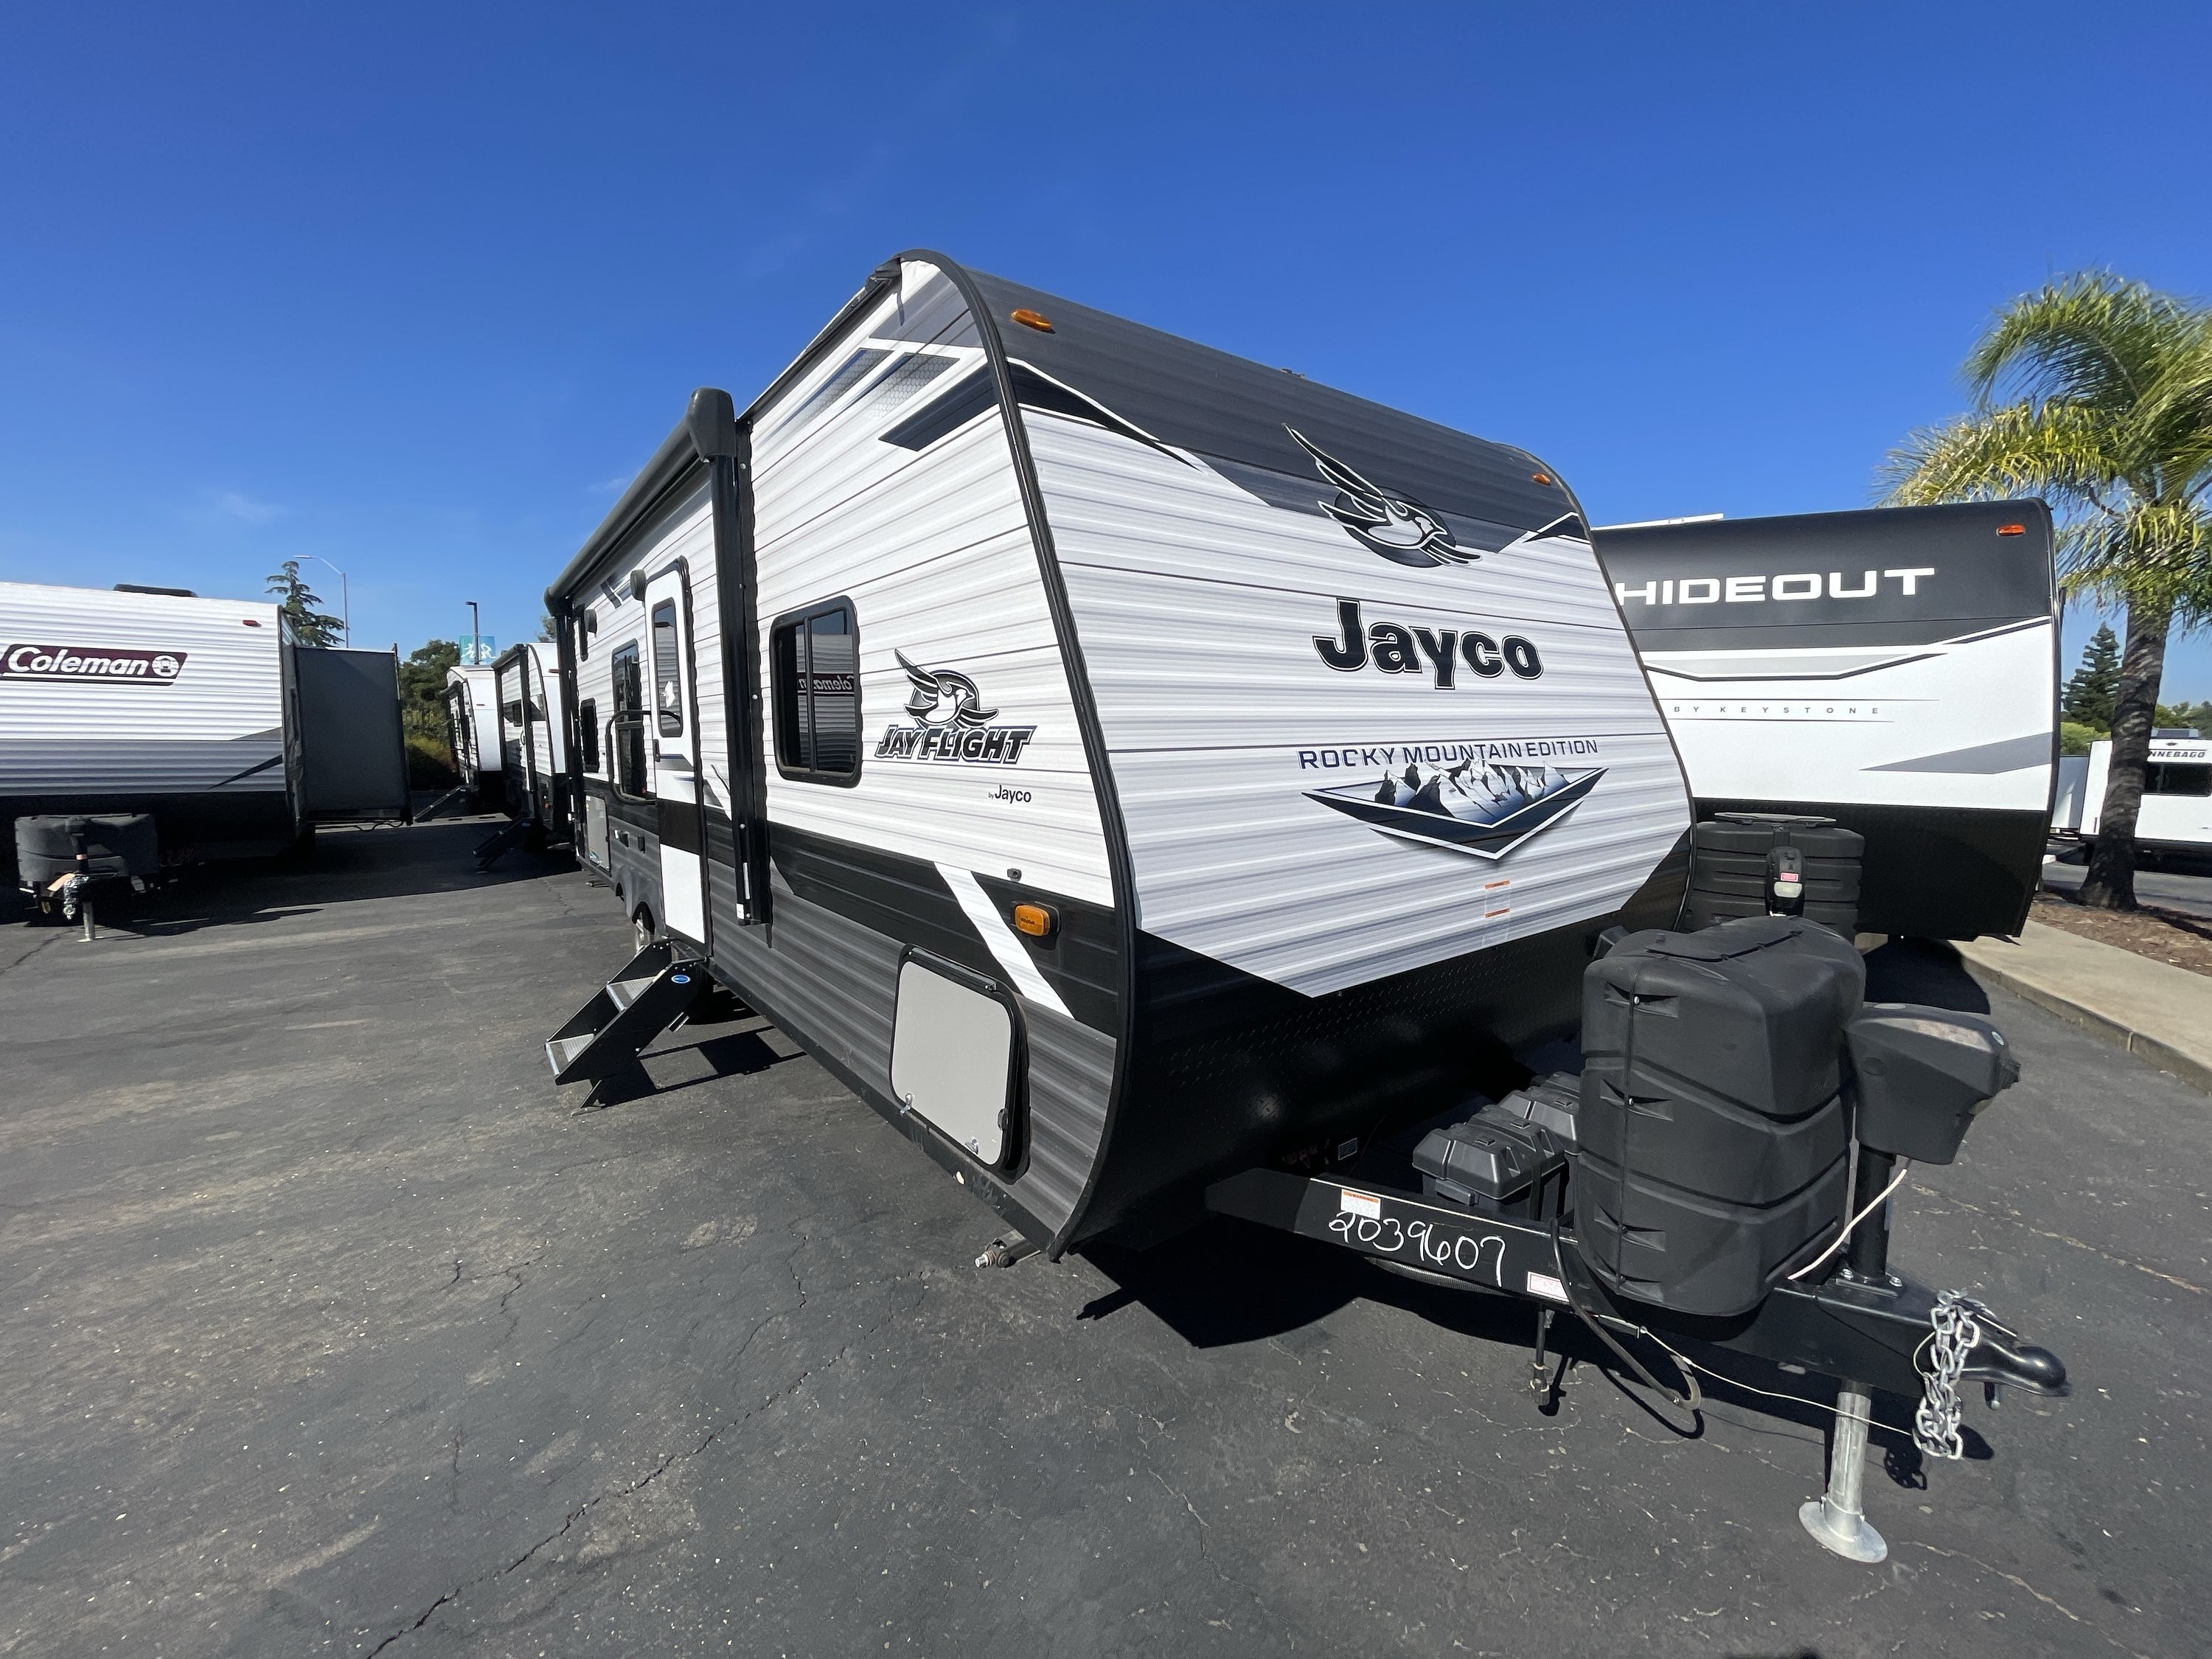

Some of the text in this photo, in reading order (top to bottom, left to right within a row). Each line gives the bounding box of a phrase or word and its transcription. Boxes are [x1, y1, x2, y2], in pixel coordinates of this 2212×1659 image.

[1615, 568, 1935, 606] HIDEOUT
[1312, 597, 1544, 690] Jayco
[7, 646, 150, 675] Coleman
[1673, 706, 1879, 715] BY KEYSTONE
[874, 724, 1038, 765] JAY FLIGHT
[1298, 739, 1599, 770] ROCKY MOUNTAIN EDITION
[2149, 751, 2206, 759] NNEBAGO
[995, 784, 1032, 804] Jayco
[1328, 1210, 1506, 1287] 2039607
